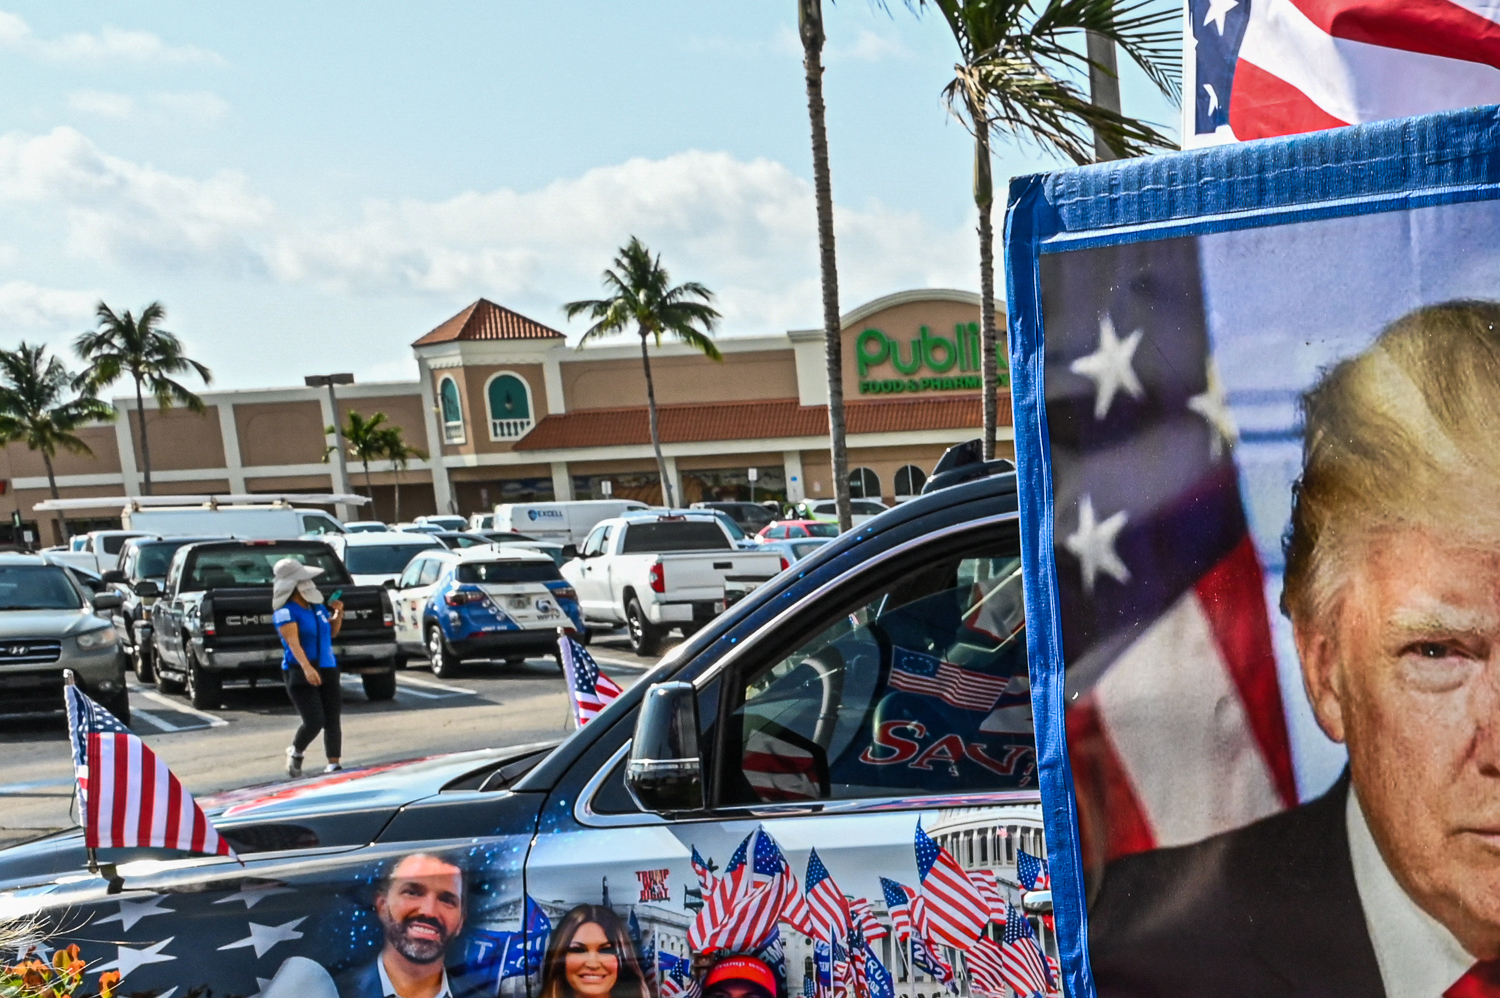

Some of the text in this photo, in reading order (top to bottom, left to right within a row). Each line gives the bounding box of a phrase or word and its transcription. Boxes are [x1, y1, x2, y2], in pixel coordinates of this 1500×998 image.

[859, 380, 905, 394] FOOD
[906, 378, 920, 392] &
[635, 869, 670, 881] TRUMP
[715, 961, 745, 970] Trump
